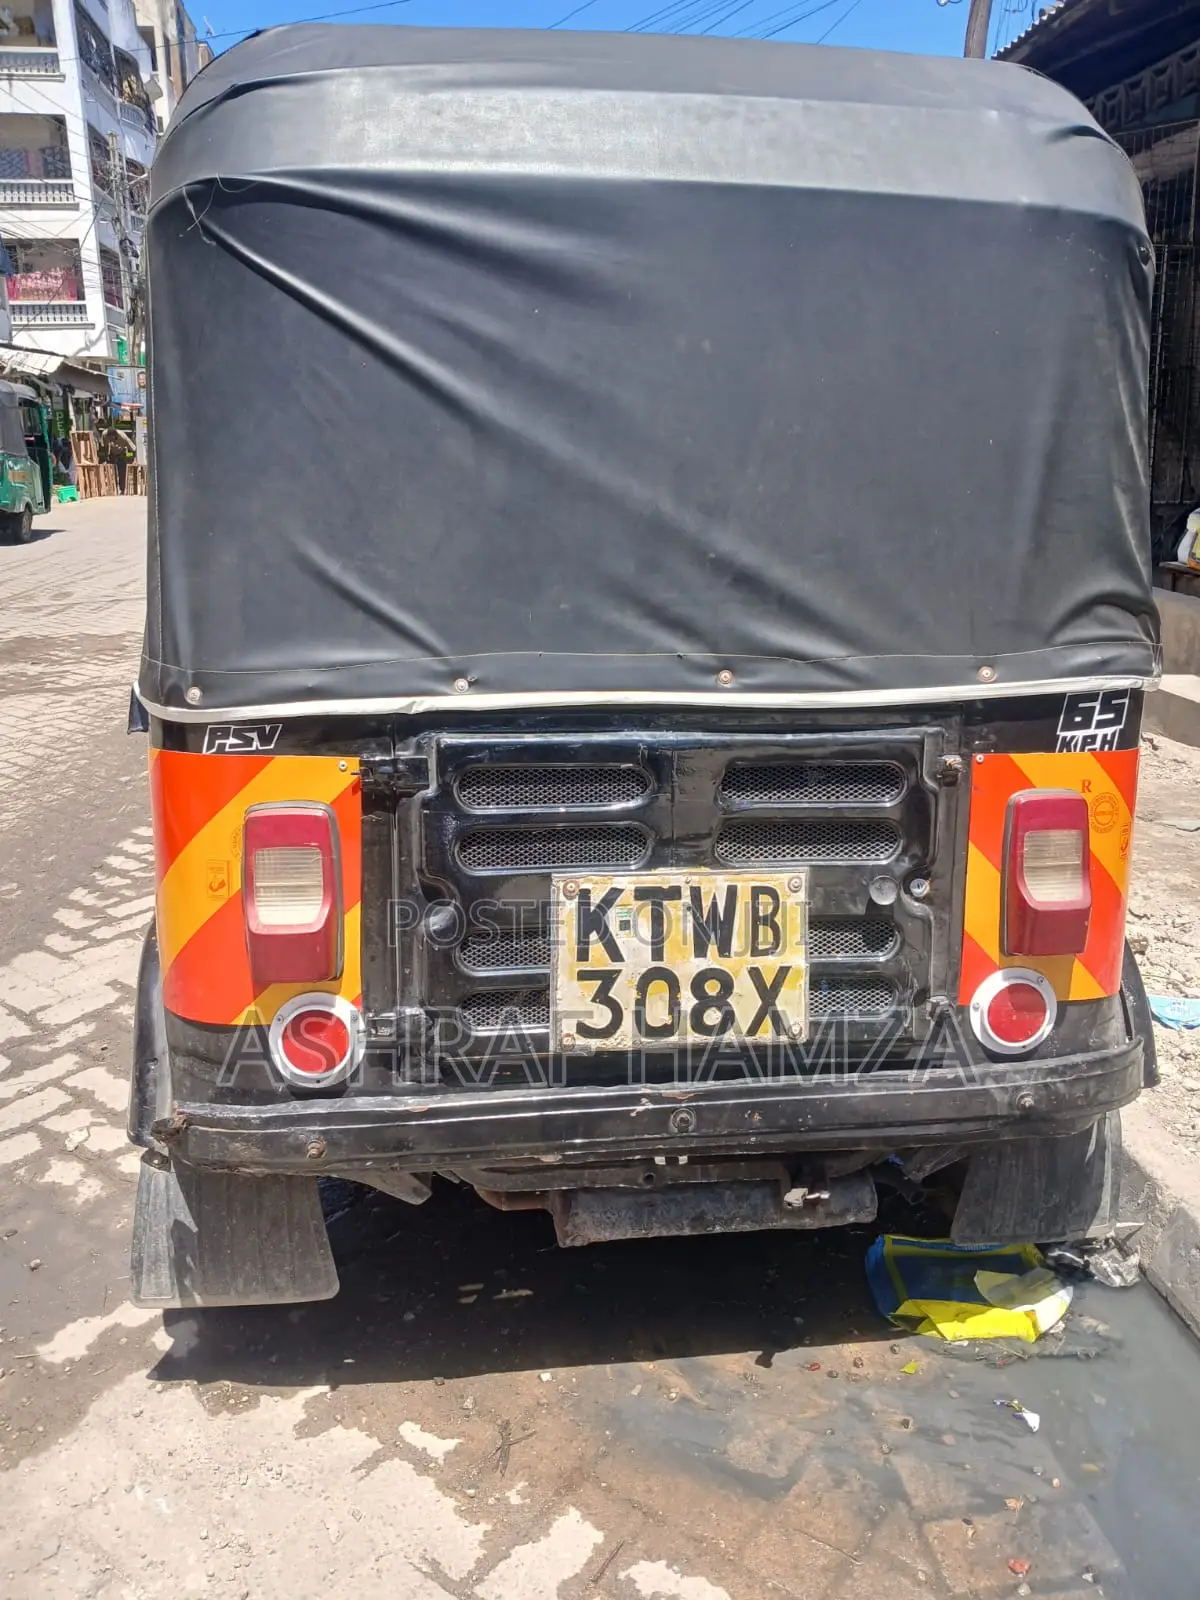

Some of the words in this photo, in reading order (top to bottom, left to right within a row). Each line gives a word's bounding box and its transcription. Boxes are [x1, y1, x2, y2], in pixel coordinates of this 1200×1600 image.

[202, 724, 283, 755] PSV
[576, 884, 781, 962] KTWB
[575, 965, 792, 1040] 308X
